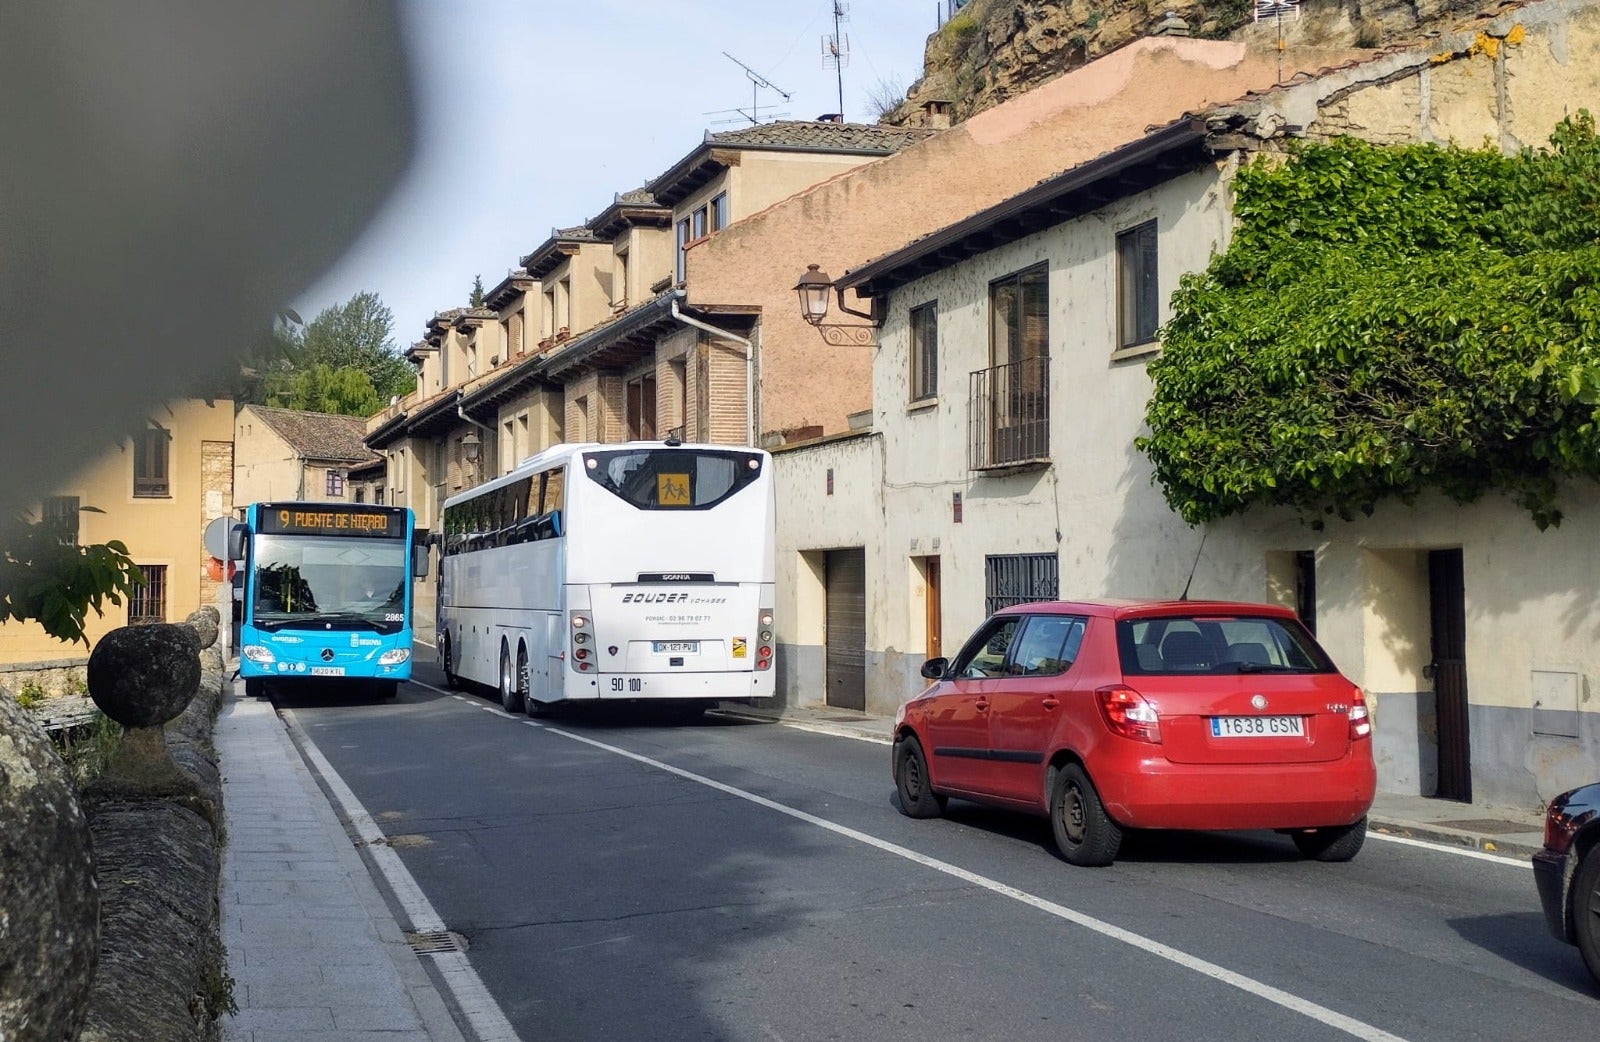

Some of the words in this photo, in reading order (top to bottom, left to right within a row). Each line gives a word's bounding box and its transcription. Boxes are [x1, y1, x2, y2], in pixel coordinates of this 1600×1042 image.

[280, 510, 290, 528] 9
[295, 512, 334, 528] PUENTE
[335, 513, 349, 528] DE
[350, 514, 388, 529] HIERRO
[622, 593, 689, 604] BOUDER
[385, 613, 404, 622] 2865
[611, 677, 624, 692] 90
[628, 678, 641, 692] 100
[1224, 718, 1264, 734] 1638
[1270, 717, 1300, 734] GSN
